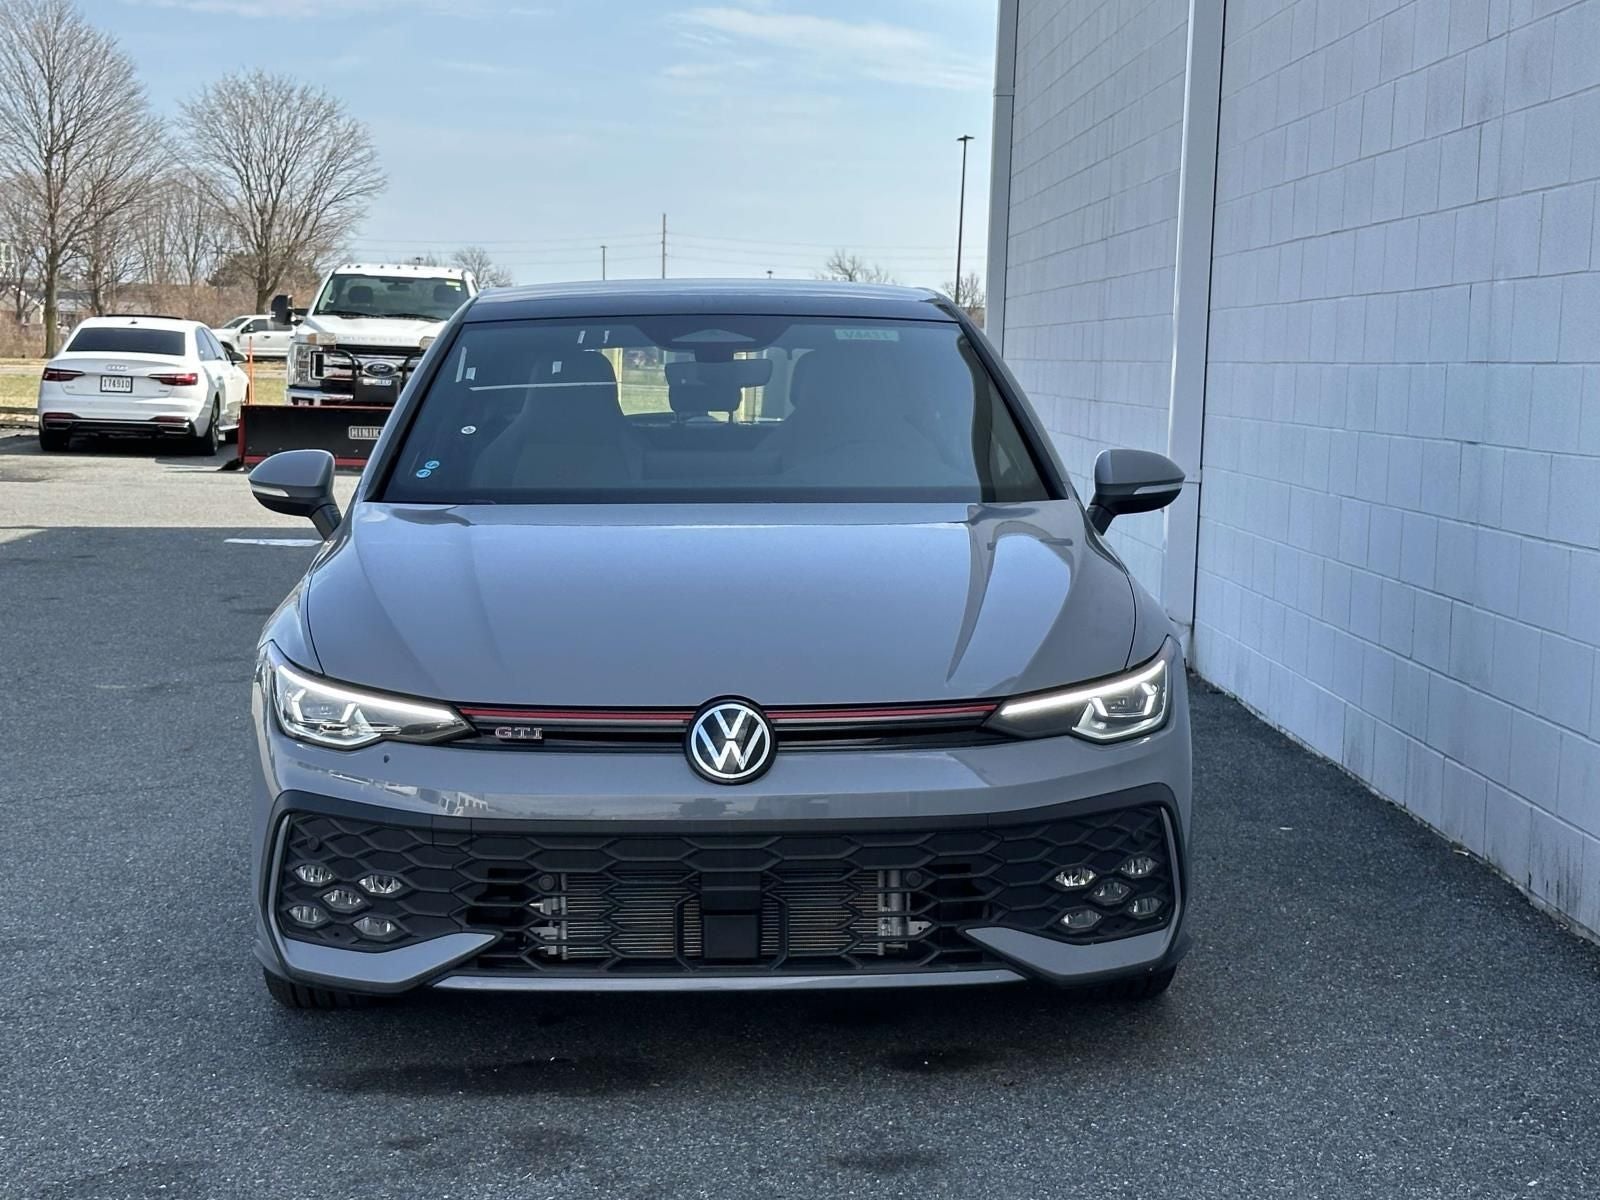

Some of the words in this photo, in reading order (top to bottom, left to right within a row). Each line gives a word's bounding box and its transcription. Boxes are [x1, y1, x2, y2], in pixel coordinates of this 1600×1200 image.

[351, 428, 384, 437] HINIK
[494, 726, 542, 740] GTI
[696, 707, 765, 771] VW
